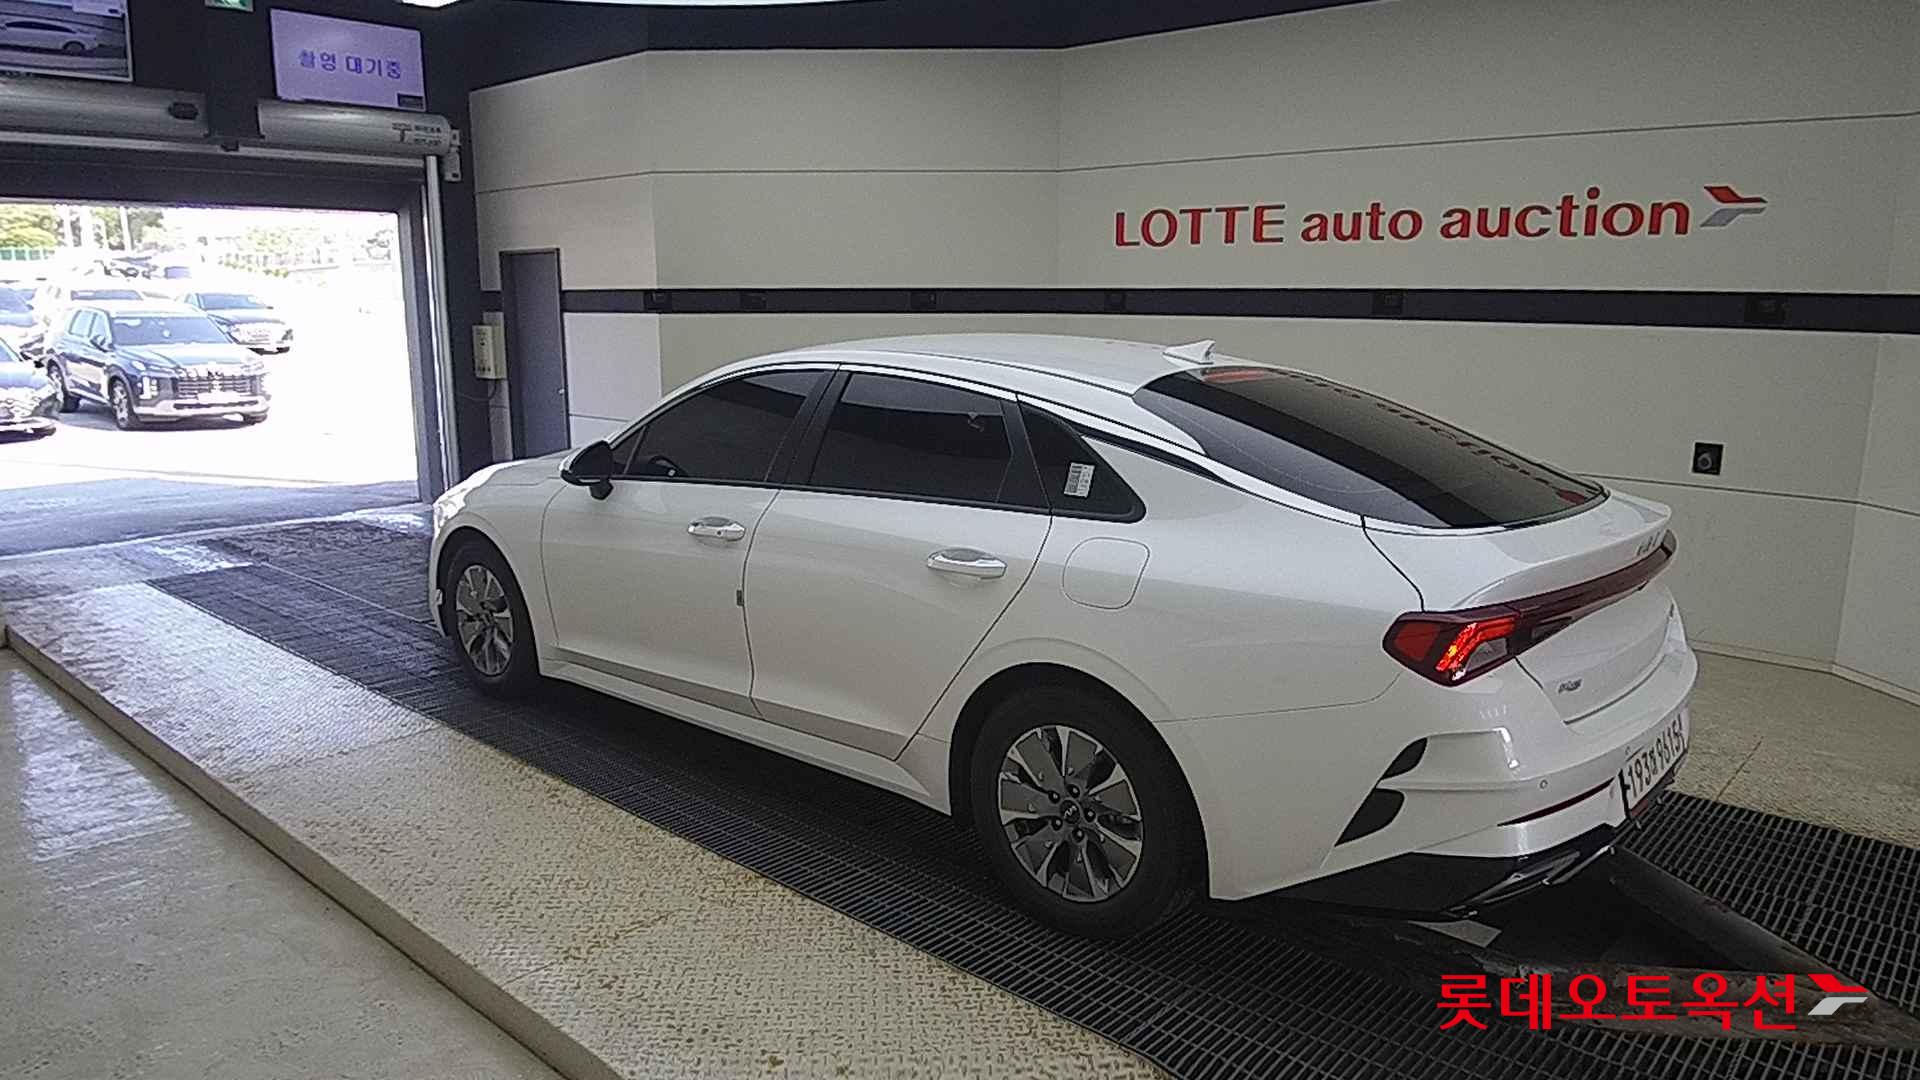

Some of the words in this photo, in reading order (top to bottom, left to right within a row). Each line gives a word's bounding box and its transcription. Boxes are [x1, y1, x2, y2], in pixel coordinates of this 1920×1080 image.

[345, 55, 402, 80] 대기중
[1114, 204, 1286, 247] LOTTE
[1301, 201, 1424, 242] auto
[1440, 186, 1690, 238] auction
